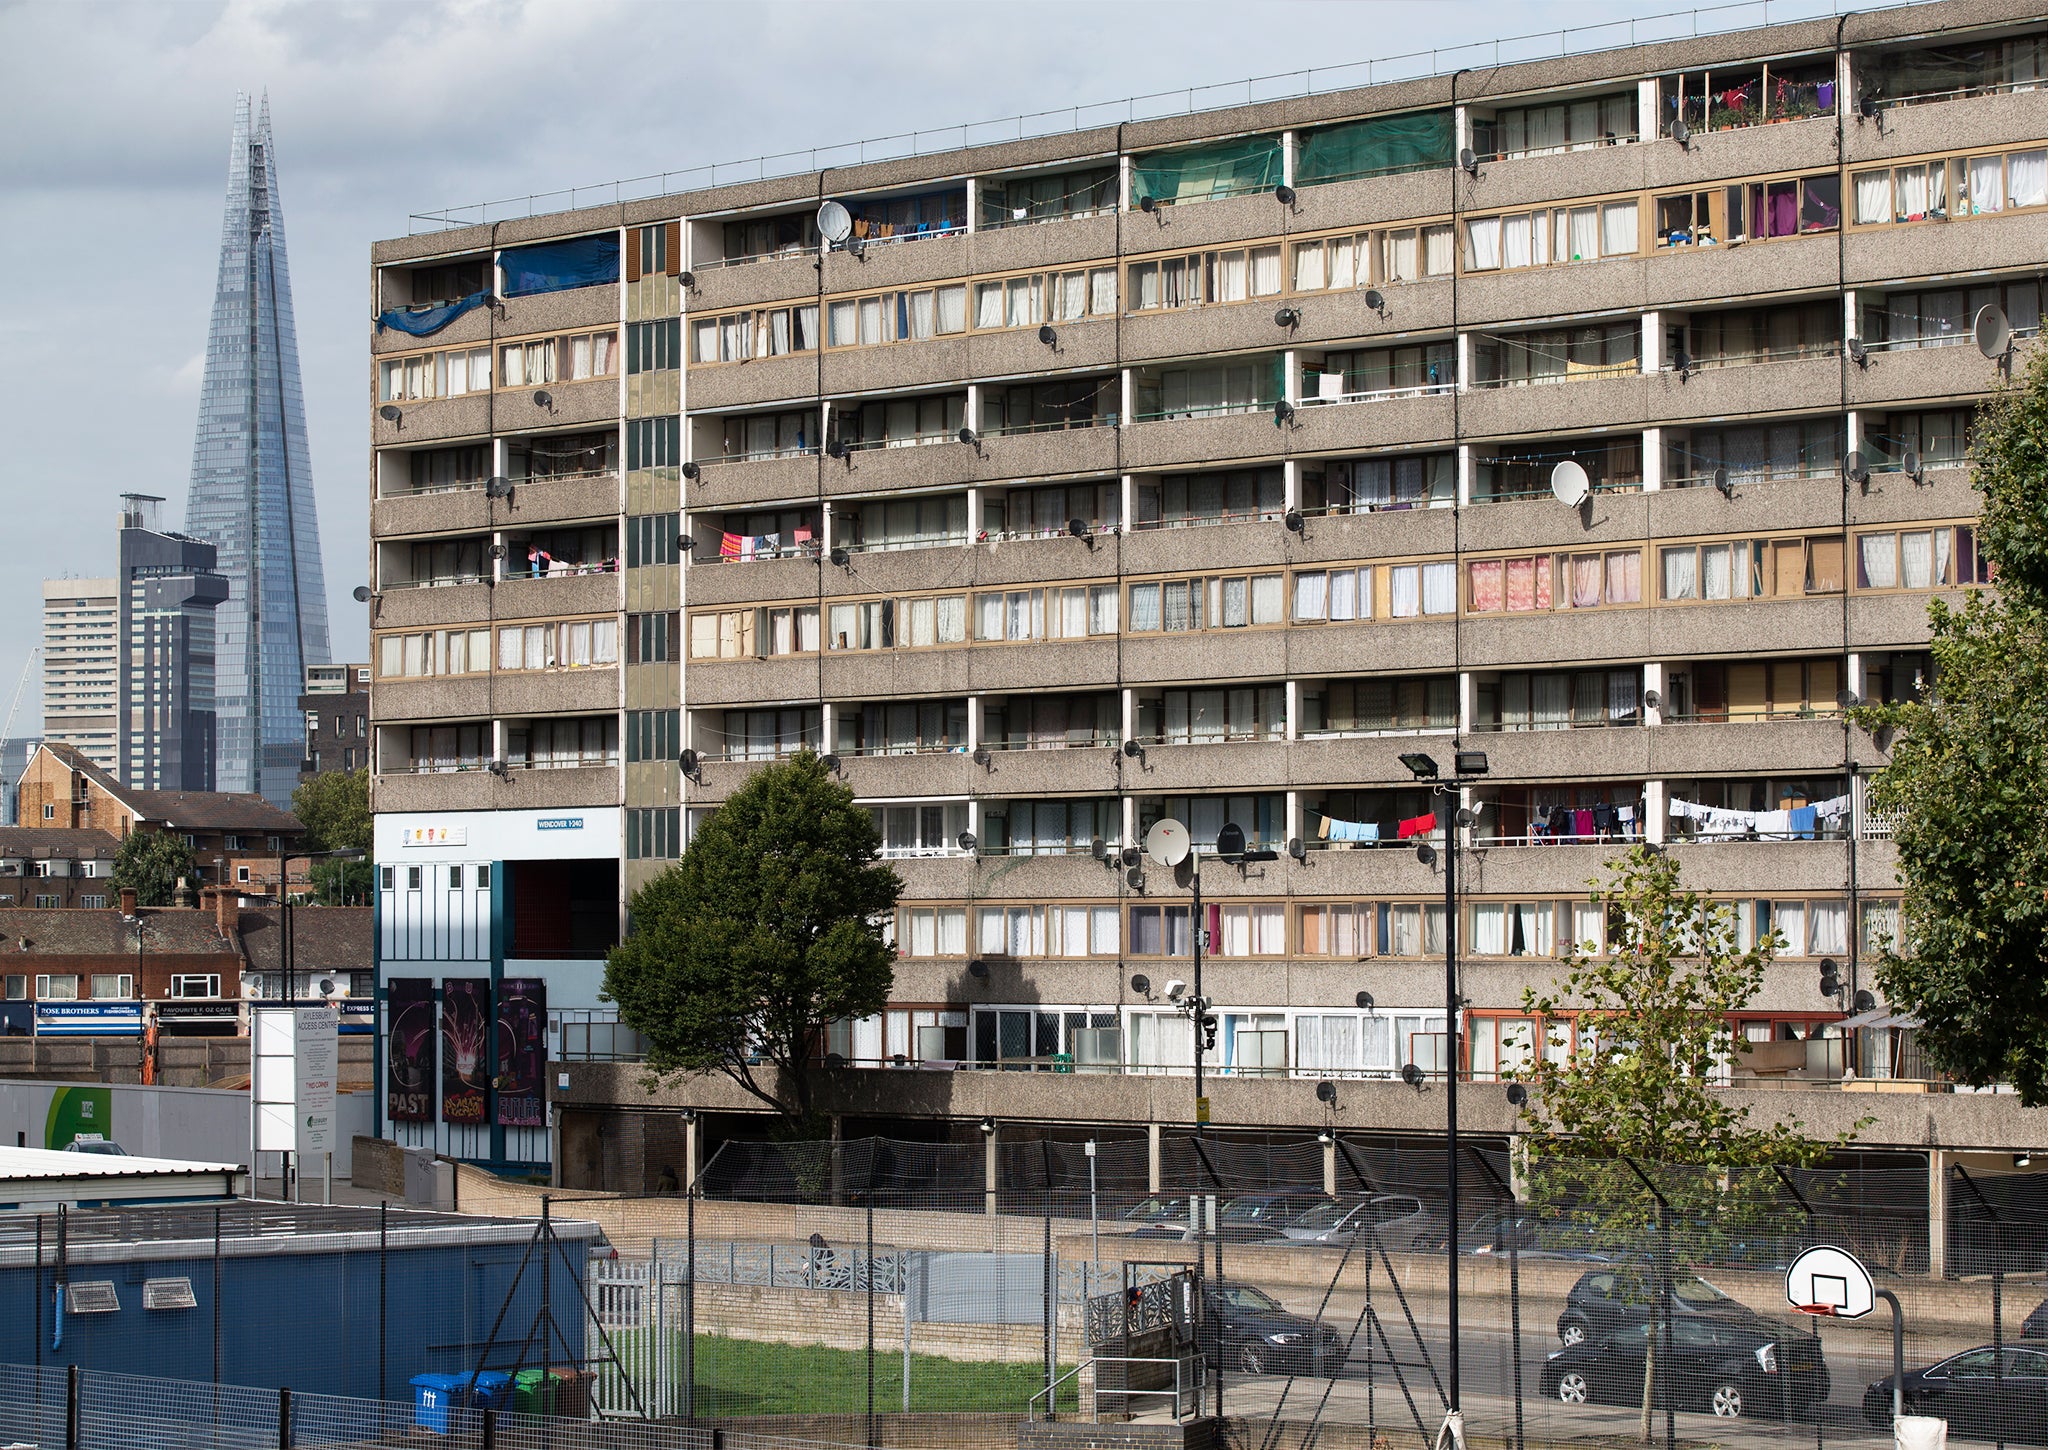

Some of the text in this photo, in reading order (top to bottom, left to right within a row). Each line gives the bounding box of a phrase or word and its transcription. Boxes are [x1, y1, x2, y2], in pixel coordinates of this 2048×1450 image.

[538, 819, 583, 828] WENDOVER 1-240
[303, 1011, 332, 1020] AYLESBURY
[298, 1020, 337, 1030] ACCESS CENTRE
[389, 1093, 429, 1114] PAST
[499, 1097, 540, 1119] FUTURE
